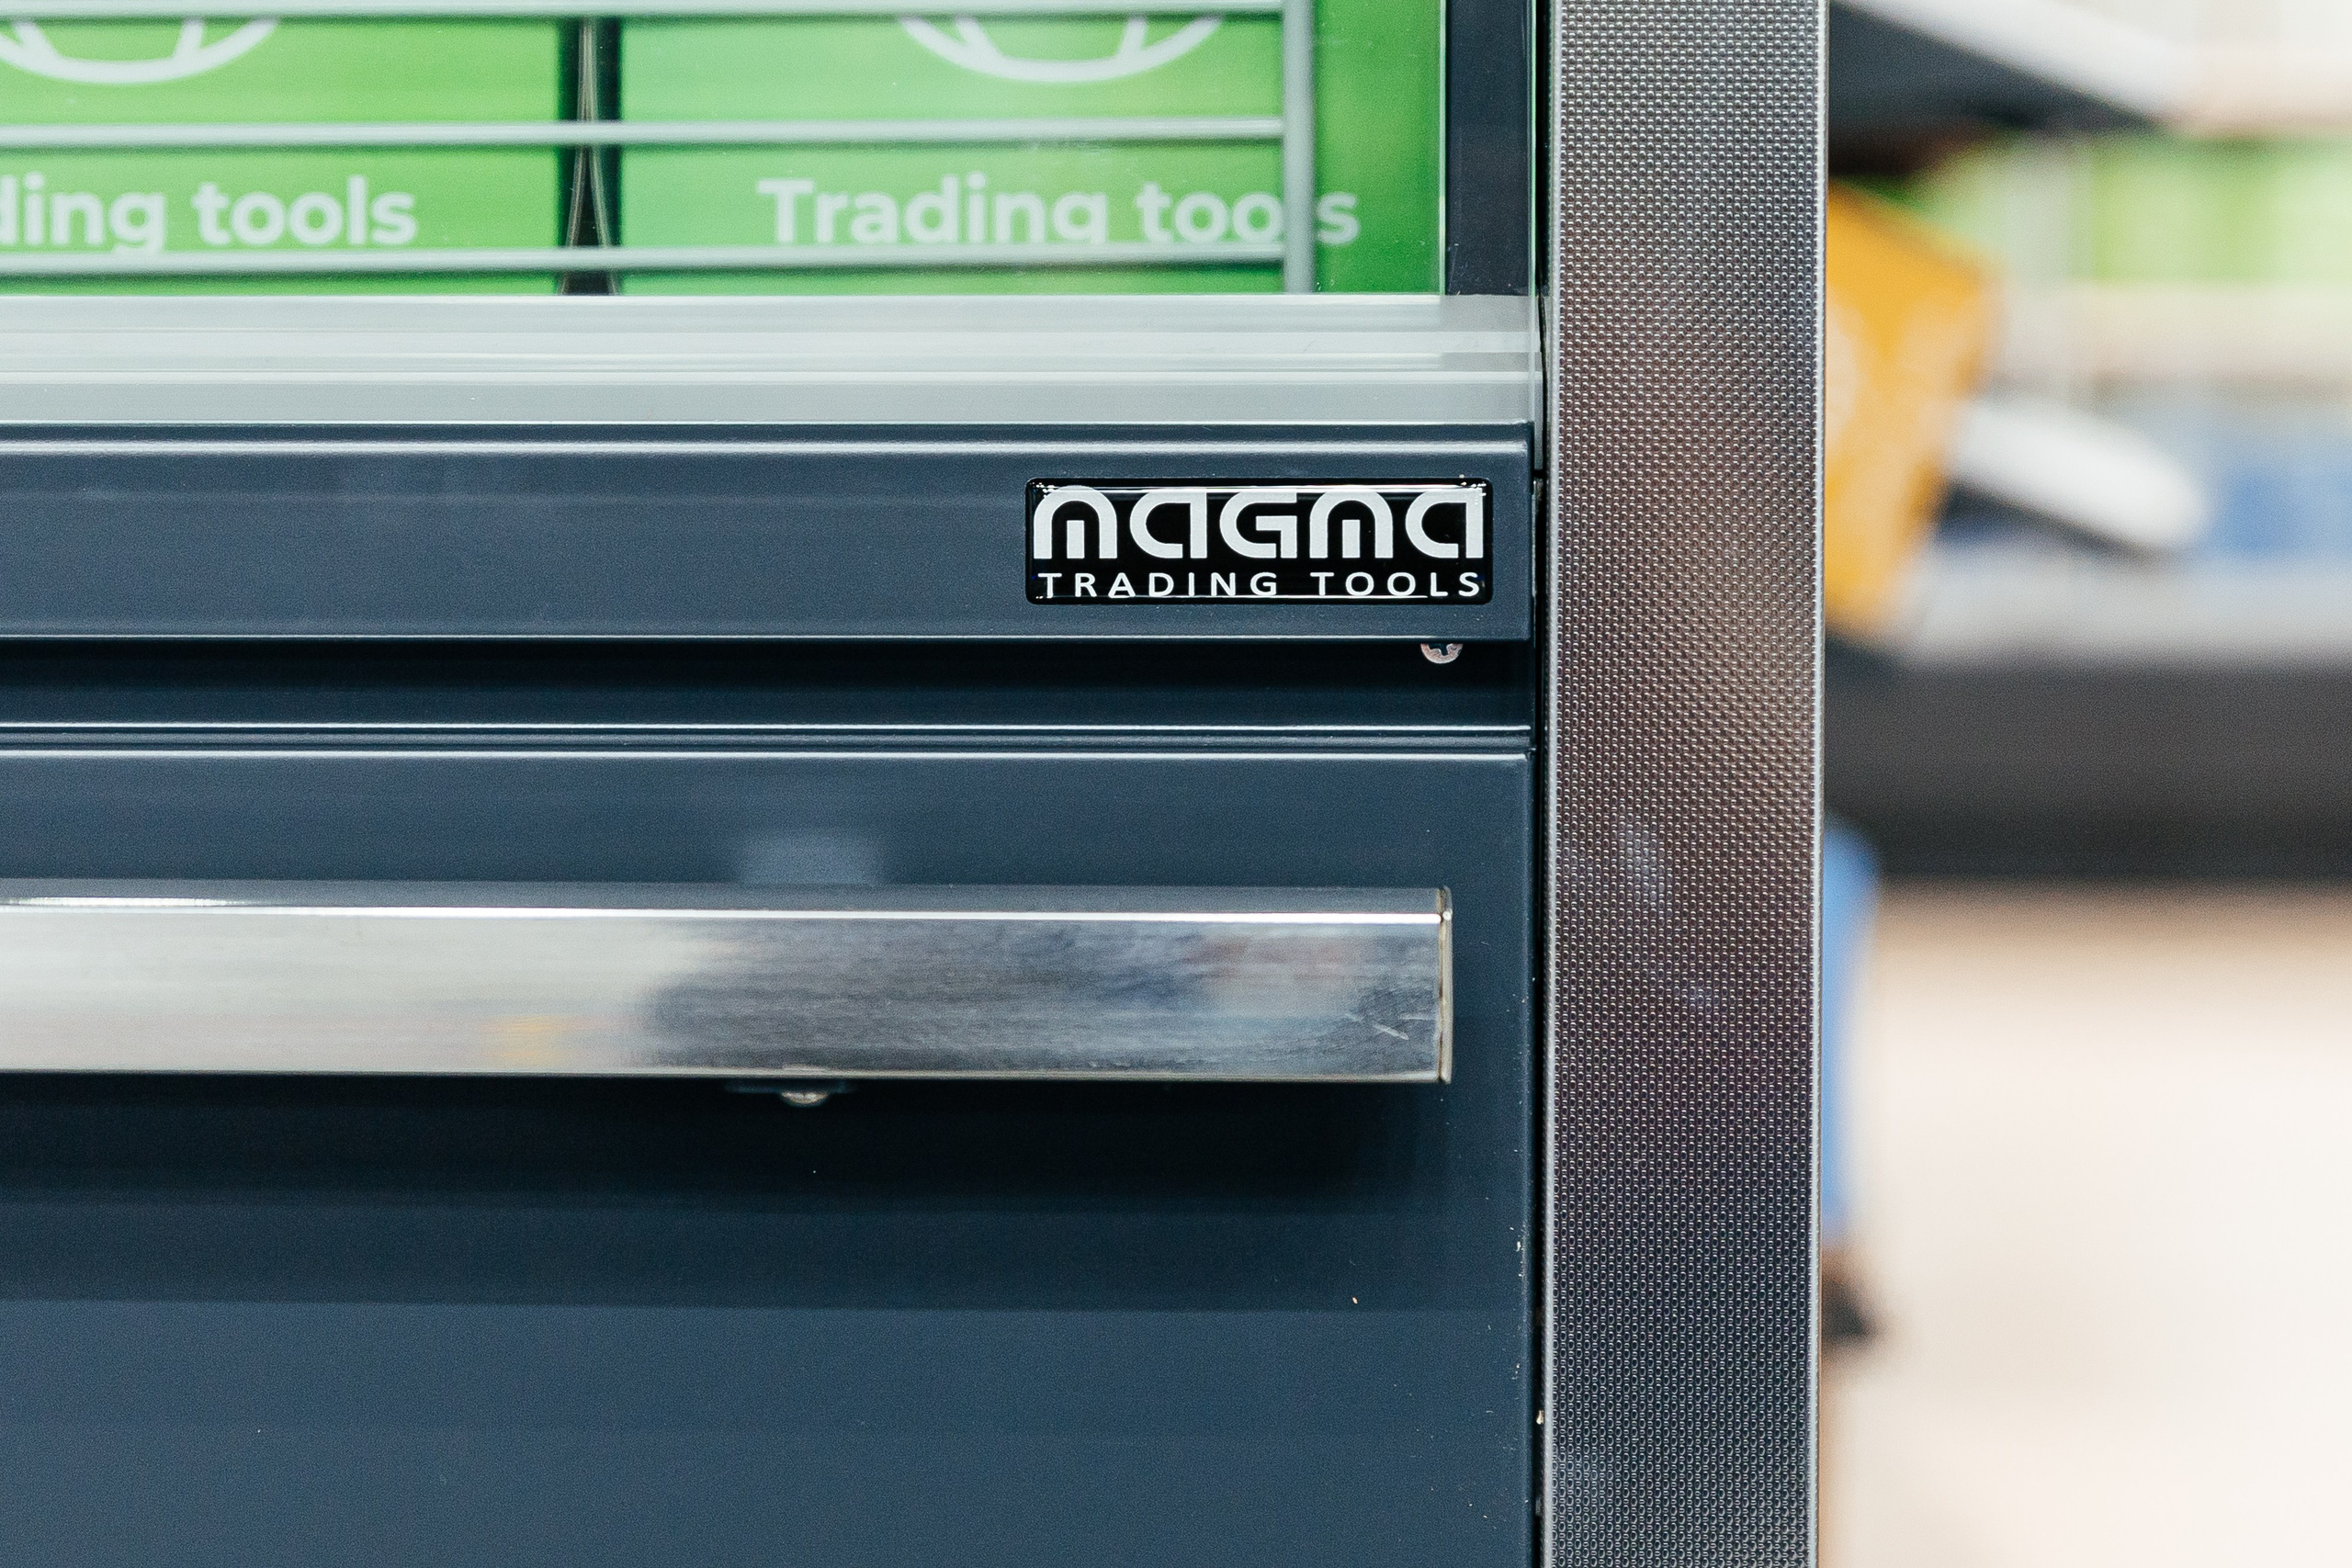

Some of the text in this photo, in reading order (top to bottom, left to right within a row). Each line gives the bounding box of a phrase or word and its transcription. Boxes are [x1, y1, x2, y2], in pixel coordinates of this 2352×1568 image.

[192, 175, 417, 245] tools
[1136, 183, 1361, 245] toos
[1038, 572, 1480, 597] TRADING TOOLS
